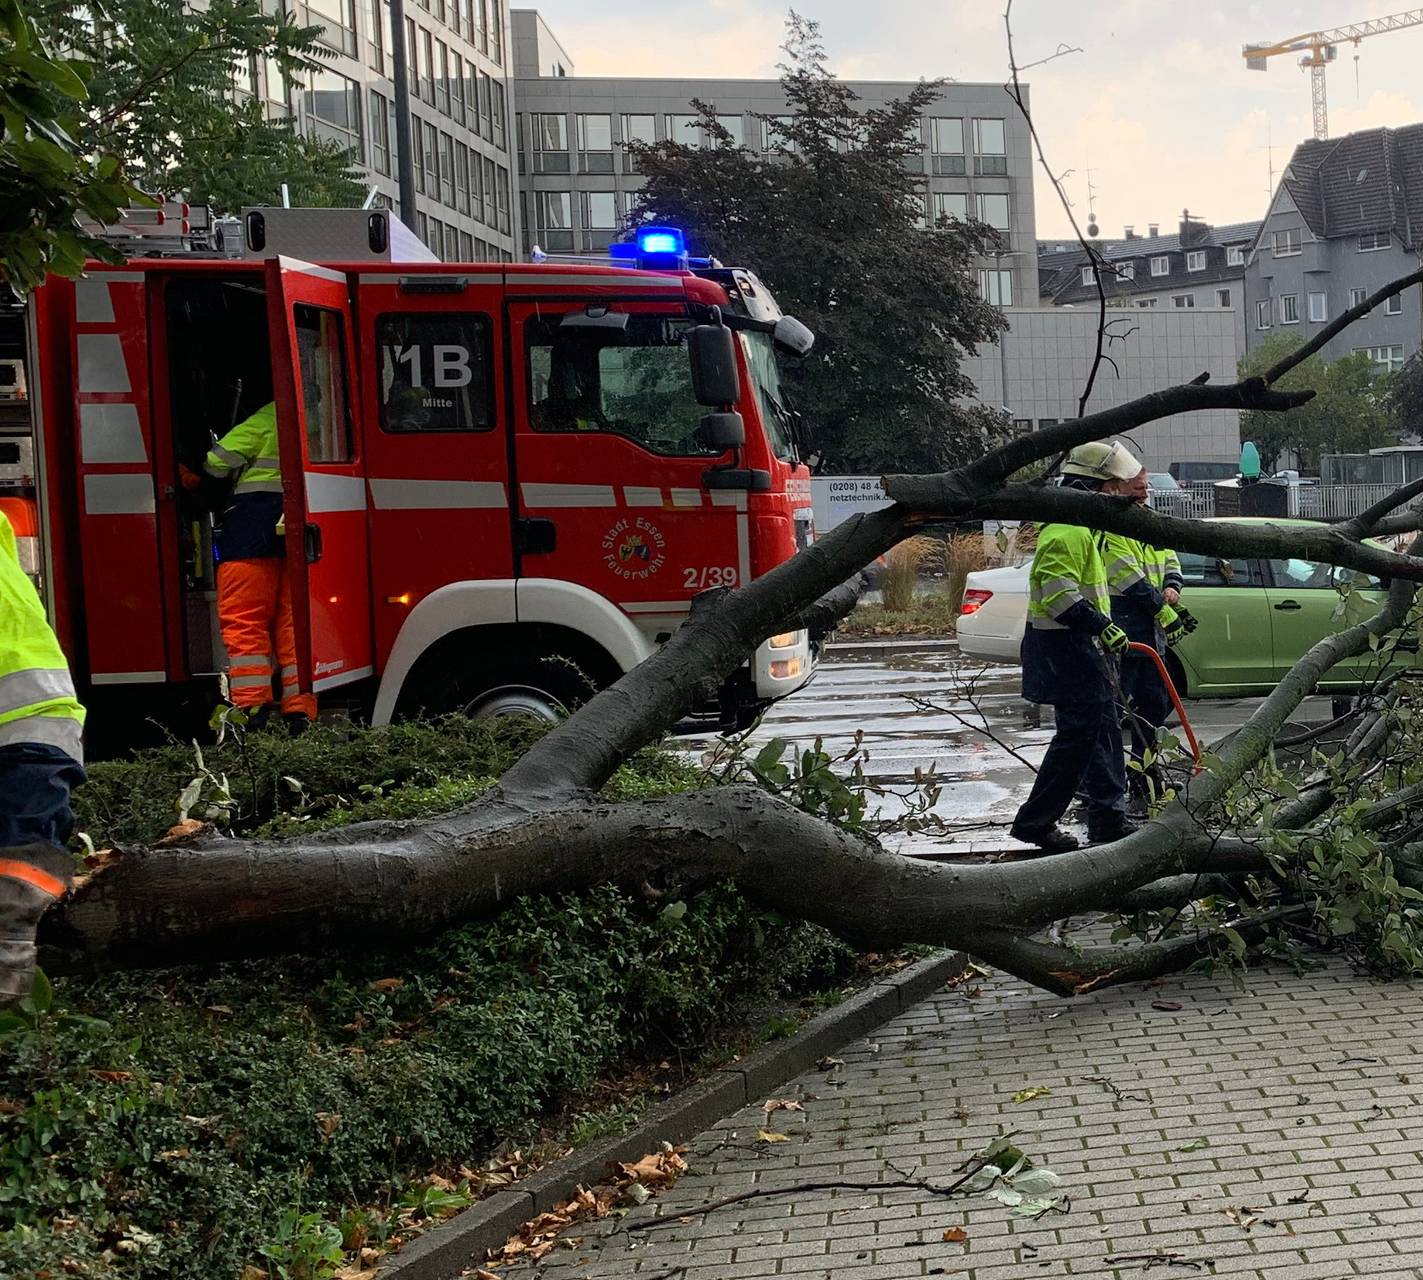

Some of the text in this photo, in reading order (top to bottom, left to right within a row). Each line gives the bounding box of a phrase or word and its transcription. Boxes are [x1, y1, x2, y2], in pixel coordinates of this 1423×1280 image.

[422, 399, 453, 407] Mitte
[829, 482, 858, 491] (0208)
[860, 482, 871, 490] 48
[830, 493, 896, 502] netztechnik.d
[602, 517, 665, 549] Stadt Essen
[603, 554, 666, 580] Feuerwehr
[683, 567, 737, 588] 2/39
